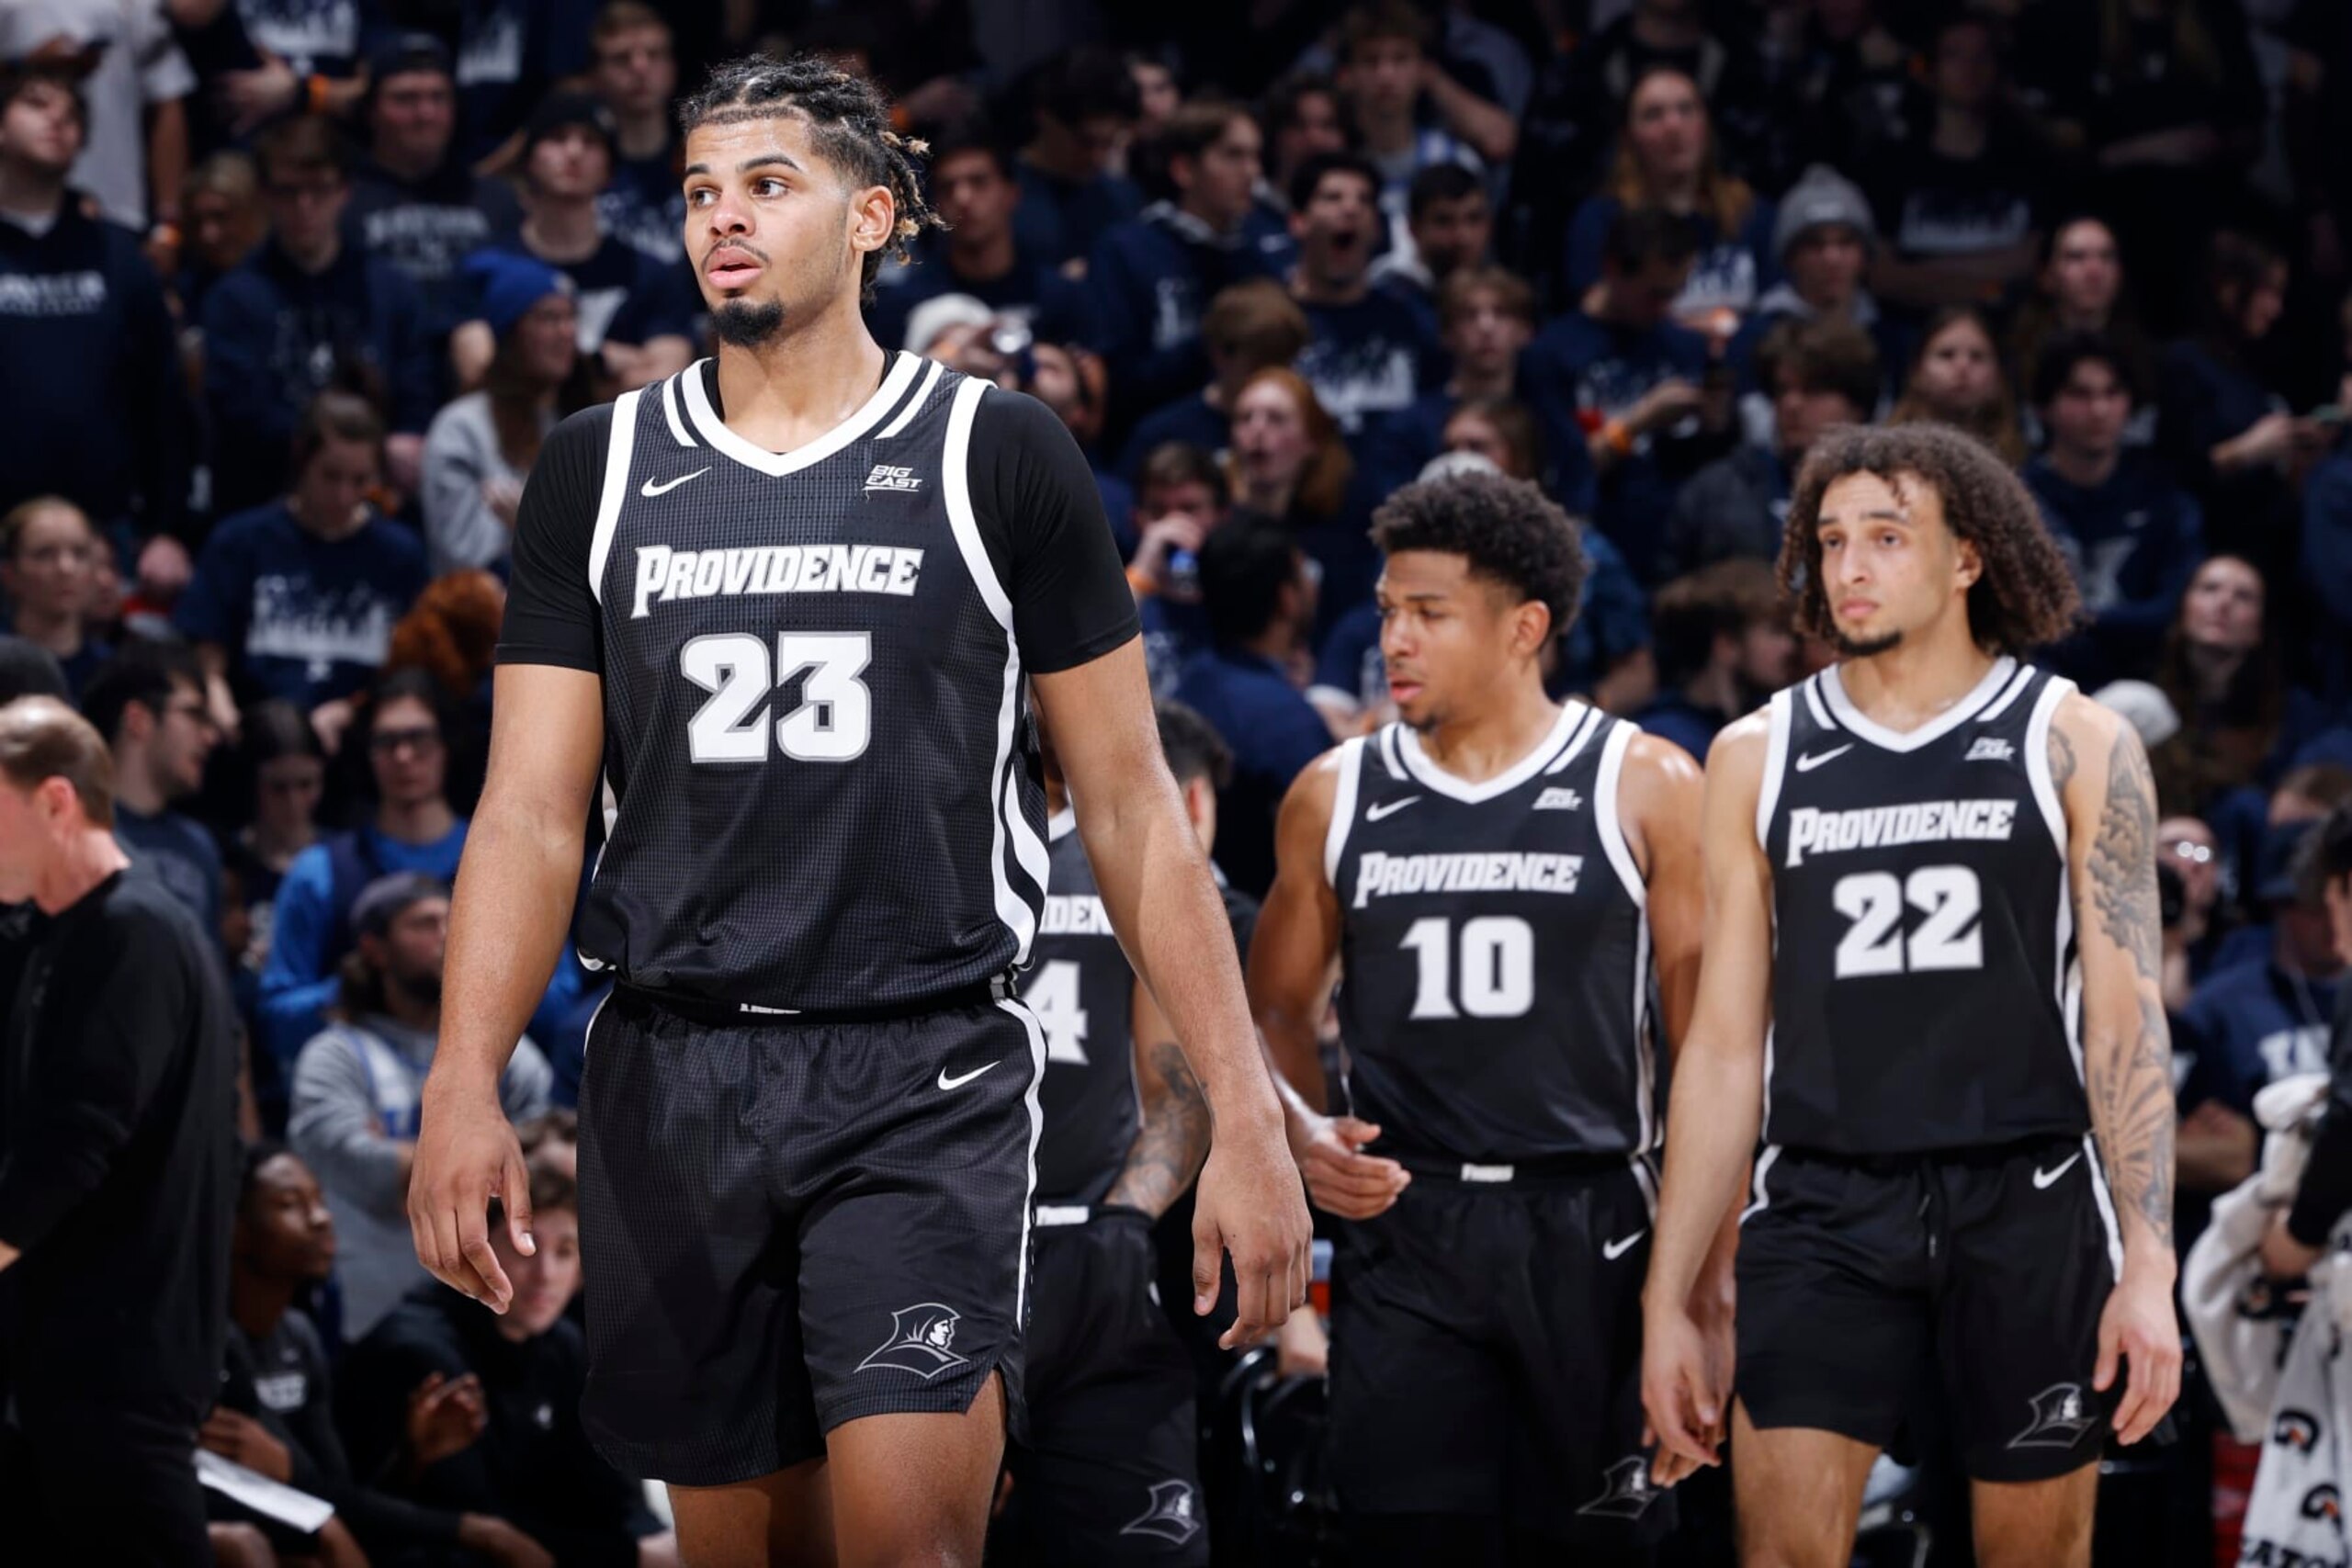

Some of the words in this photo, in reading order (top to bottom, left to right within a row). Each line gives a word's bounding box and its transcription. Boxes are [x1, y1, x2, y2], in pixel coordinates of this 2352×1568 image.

[865, 475, 922, 489] EAST
[871, 465, 913, 478] BIG
[631, 544, 924, 619] PROVIDENCE
[680, 631, 872, 763] 23
[1785, 799, 2018, 868] PROVIDENCE
[1352, 852, 1583, 908] PROVIDENCE
[1832, 863, 1984, 979] 22
[1398, 915, 1534, 1019] 10
[1021, 958, 1091, 1066] 4
